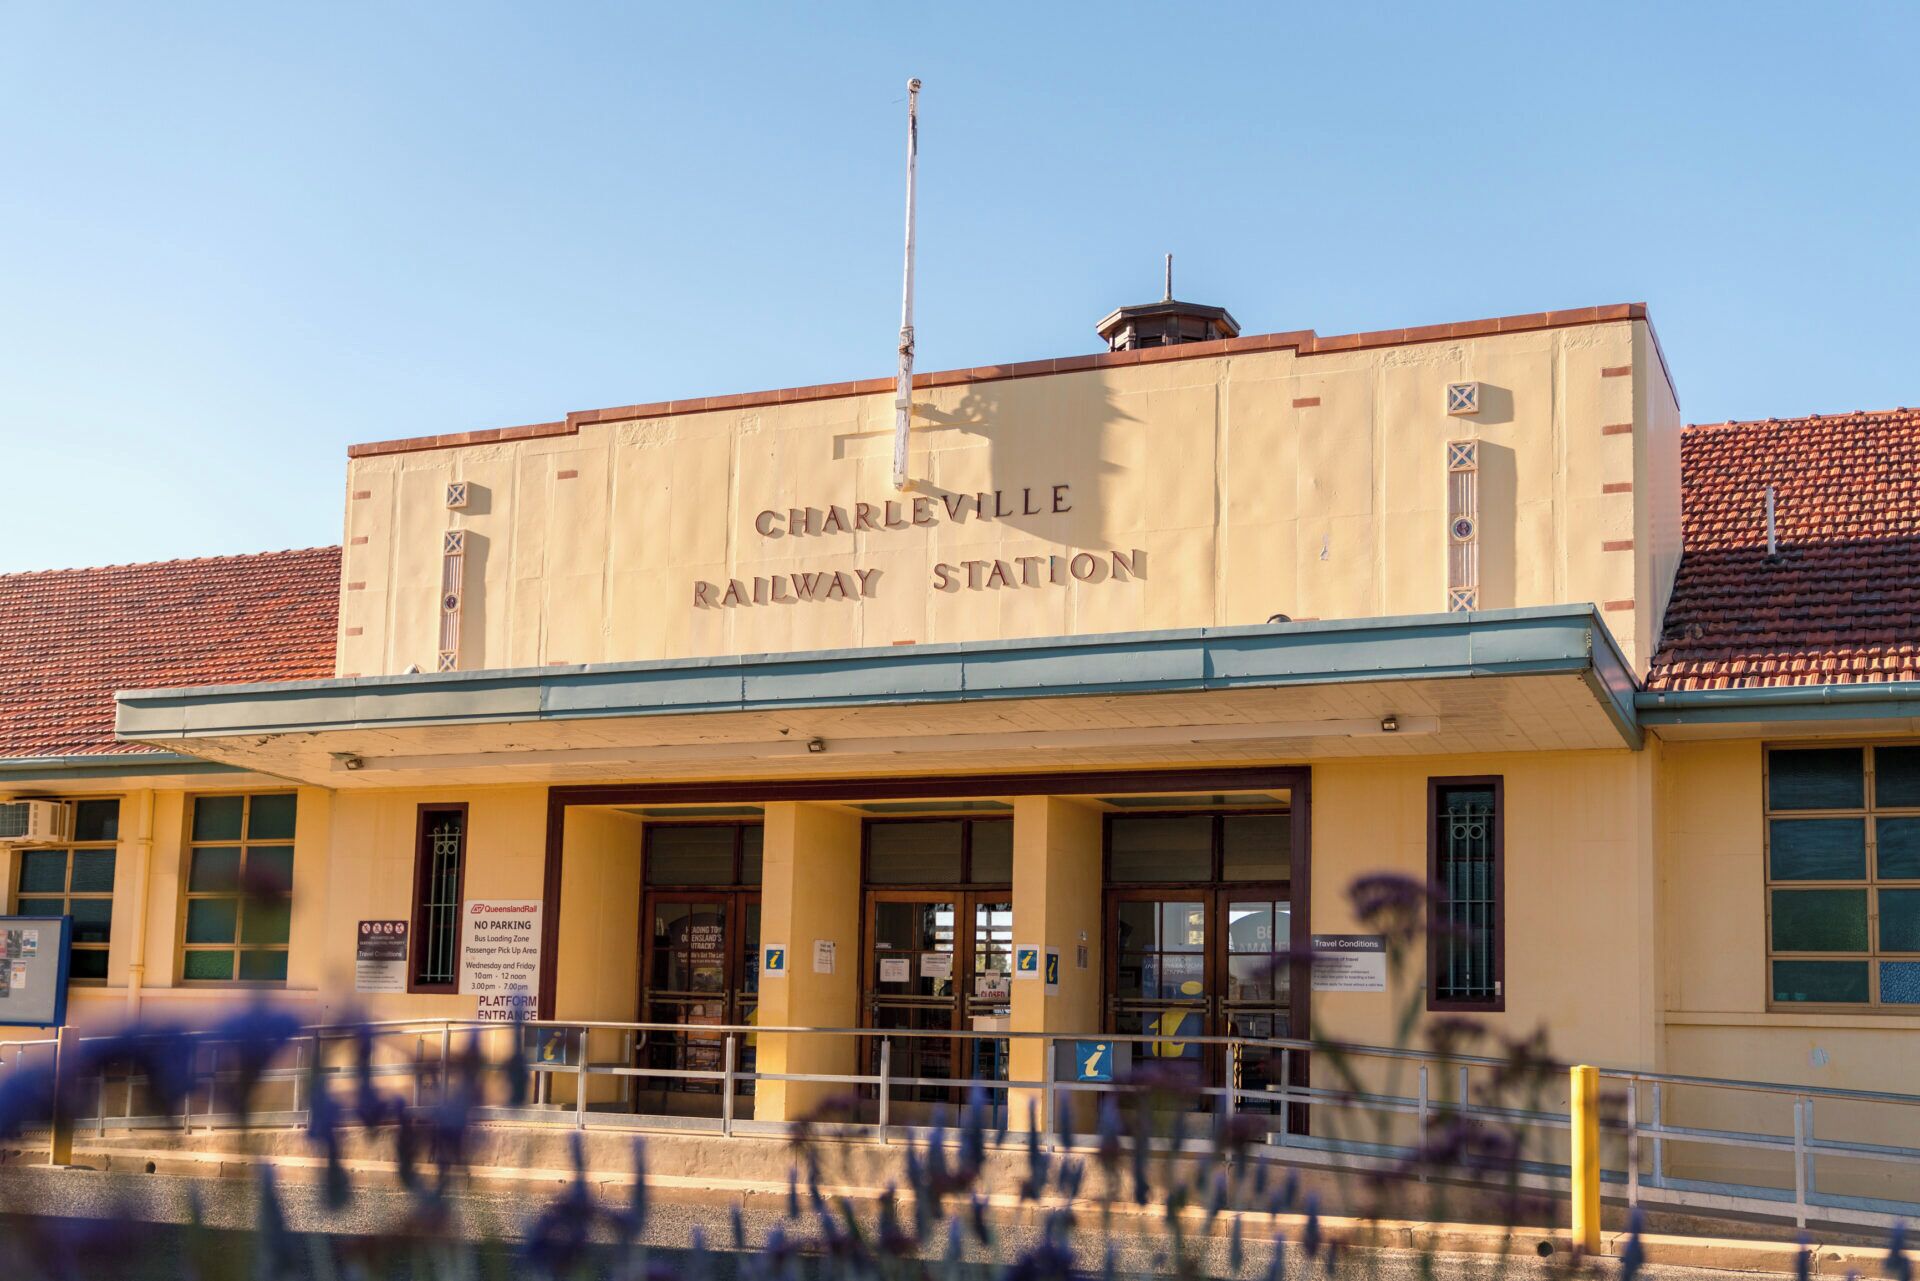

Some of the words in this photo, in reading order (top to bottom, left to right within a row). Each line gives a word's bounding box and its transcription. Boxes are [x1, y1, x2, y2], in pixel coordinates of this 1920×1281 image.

[755, 484, 1073, 537] CHARLEVILLE
[693, 568, 877, 608] RAILWAY
[933, 548, 1138, 592] STATION
[474, 921, 488, 930] NO
[490, 921, 532, 930] PARKING
[474, 934, 486, 942] Bus
[487, 934, 512, 943] Loading
[513, 934, 530, 942] Zone
[1314, 939, 1337, 948] Travel
[1338, 939, 1379, 948] Conditions
[465, 946, 497, 955] Passenger
[498, 946, 510, 954] Pick
[511, 946, 521, 955] Up
[522, 946, 537, 954] Area
[465, 961, 501, 970] Wednesday
[502, 961, 515, 969] and
[516, 962, 536, 971] Friday
[474, 972, 493, 980] 10am
[501, 972, 509, 980] 12
[471, 982, 496, 991] 3.00pm
[503, 982, 528, 991] 7.00pm
[478, 995, 537, 1007] PLATFORM
[477, 1010, 537, 1021] ENTRANCE
